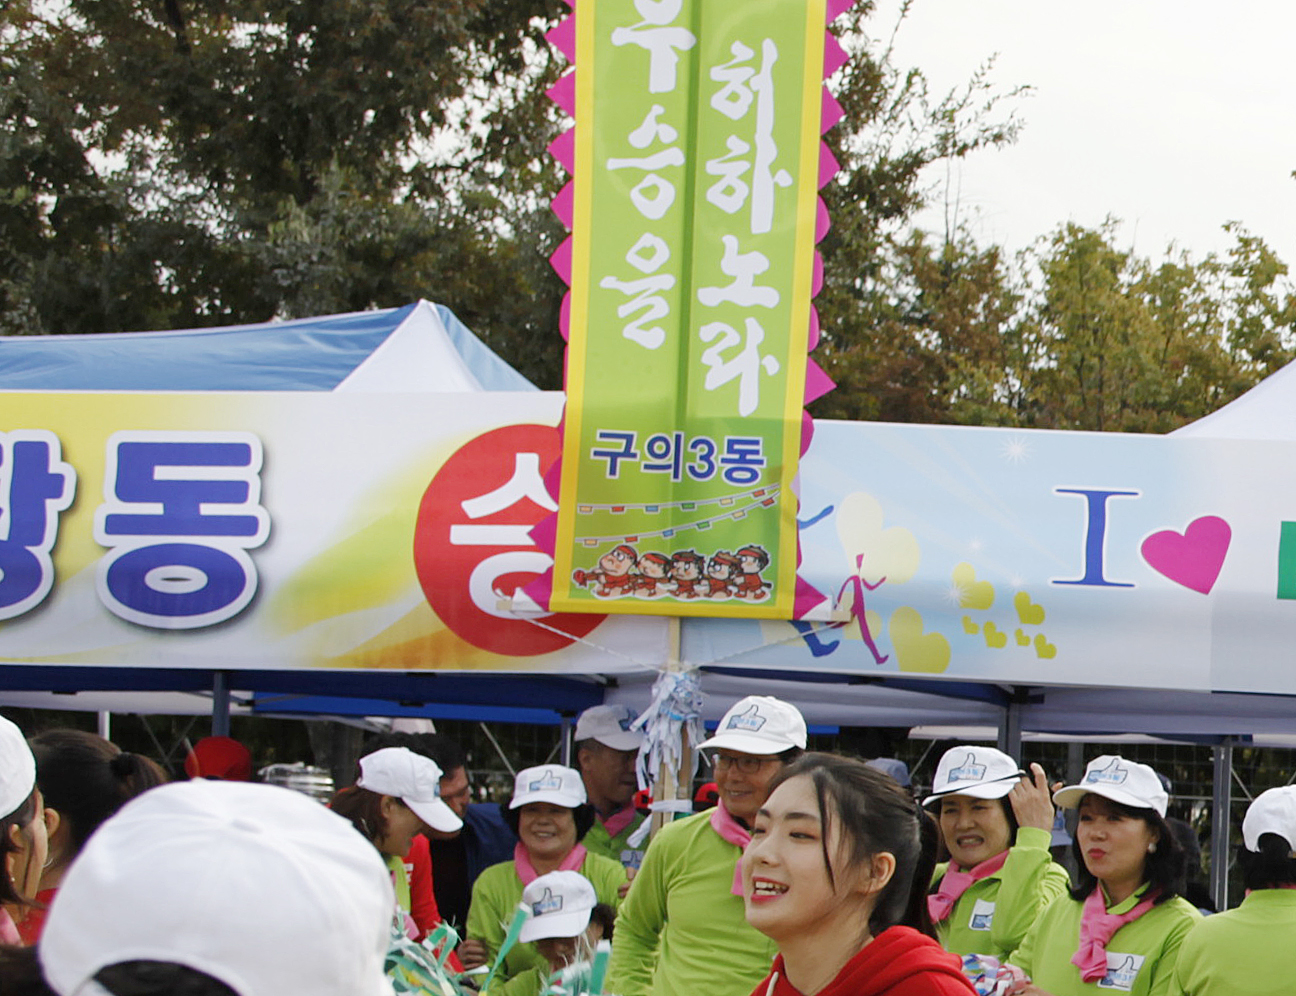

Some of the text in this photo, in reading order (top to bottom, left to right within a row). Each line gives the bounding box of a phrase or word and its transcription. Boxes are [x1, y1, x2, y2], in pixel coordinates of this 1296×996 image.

[599, 0, 697, 349] 우승을
[699, 38, 793, 417] 허하노라
[592, 430, 767, 486] 구의3동
[1052, 488, 1140, 588] I
